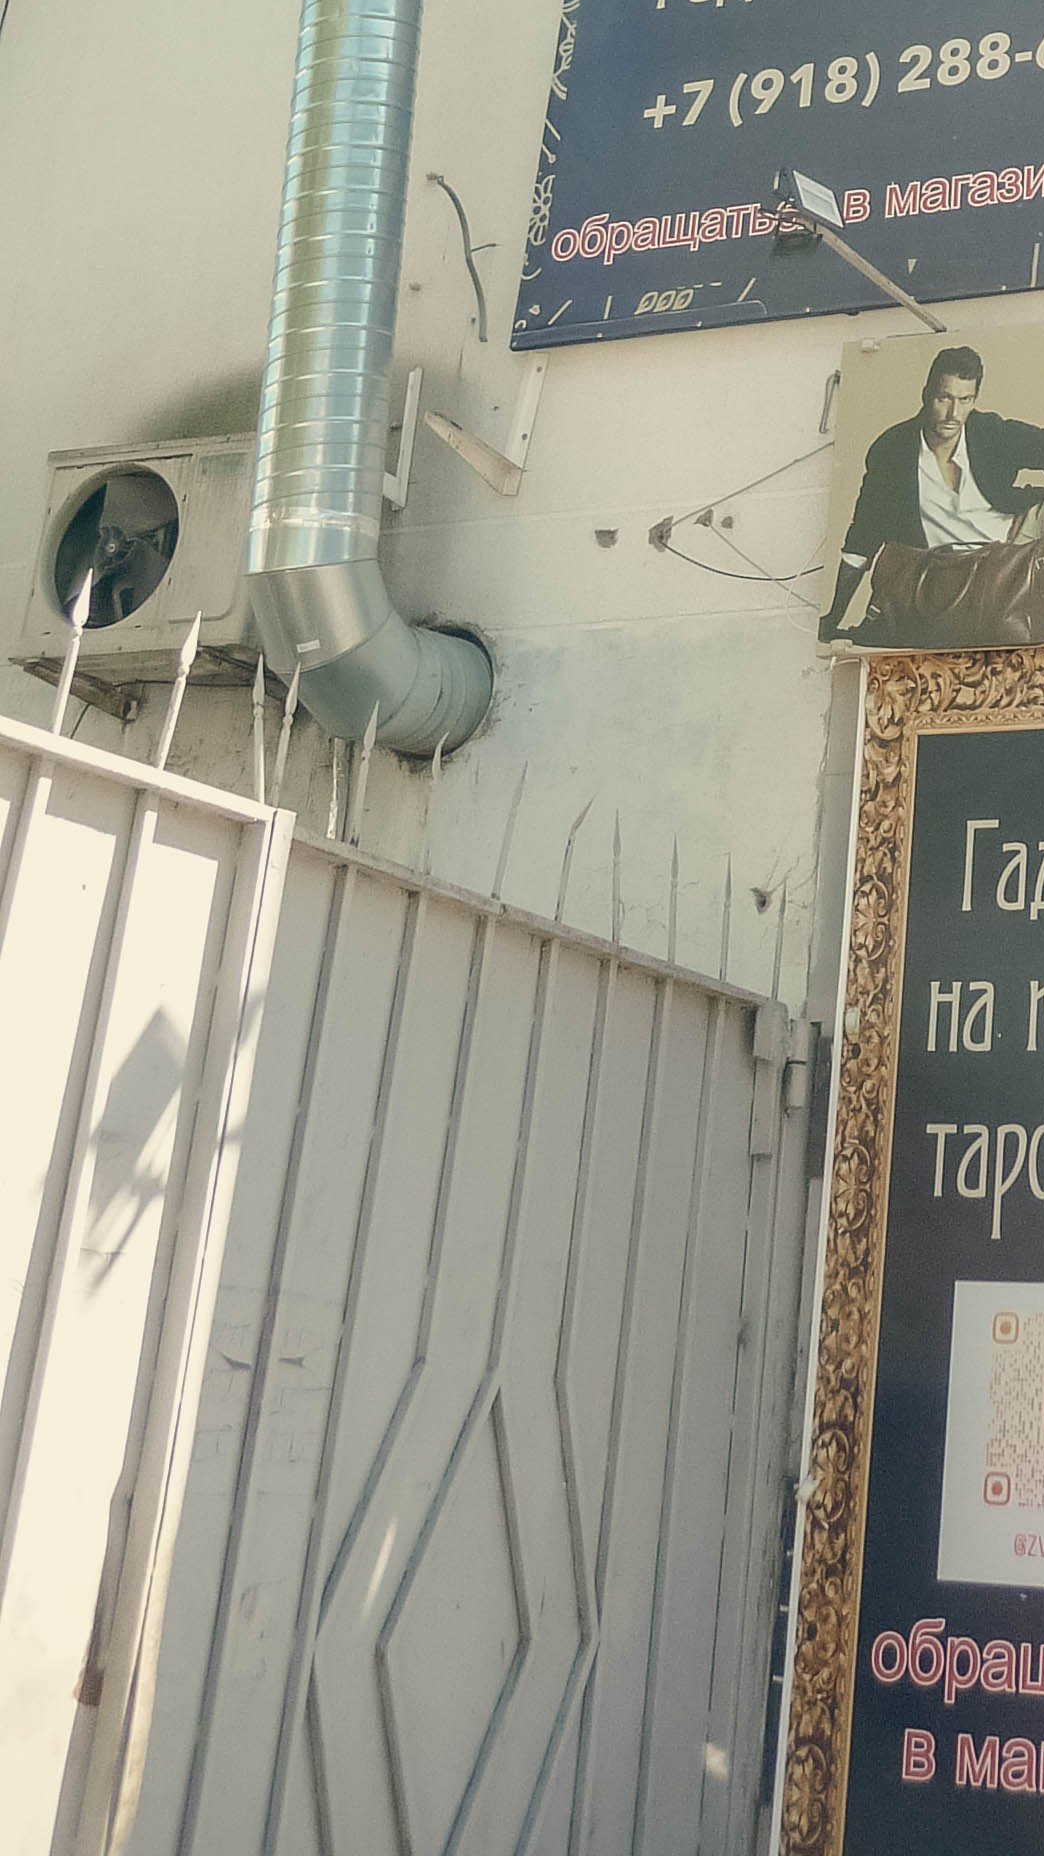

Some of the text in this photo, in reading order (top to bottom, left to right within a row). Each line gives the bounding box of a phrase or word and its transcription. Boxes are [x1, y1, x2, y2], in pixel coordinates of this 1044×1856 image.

[643, 79, 715, 129] +7
[727, 51, 882, 127] (918)
[843, 186, 871, 224] в
[926, 980, 995, 1053] на
[901, 1727, 938, 1782] в
